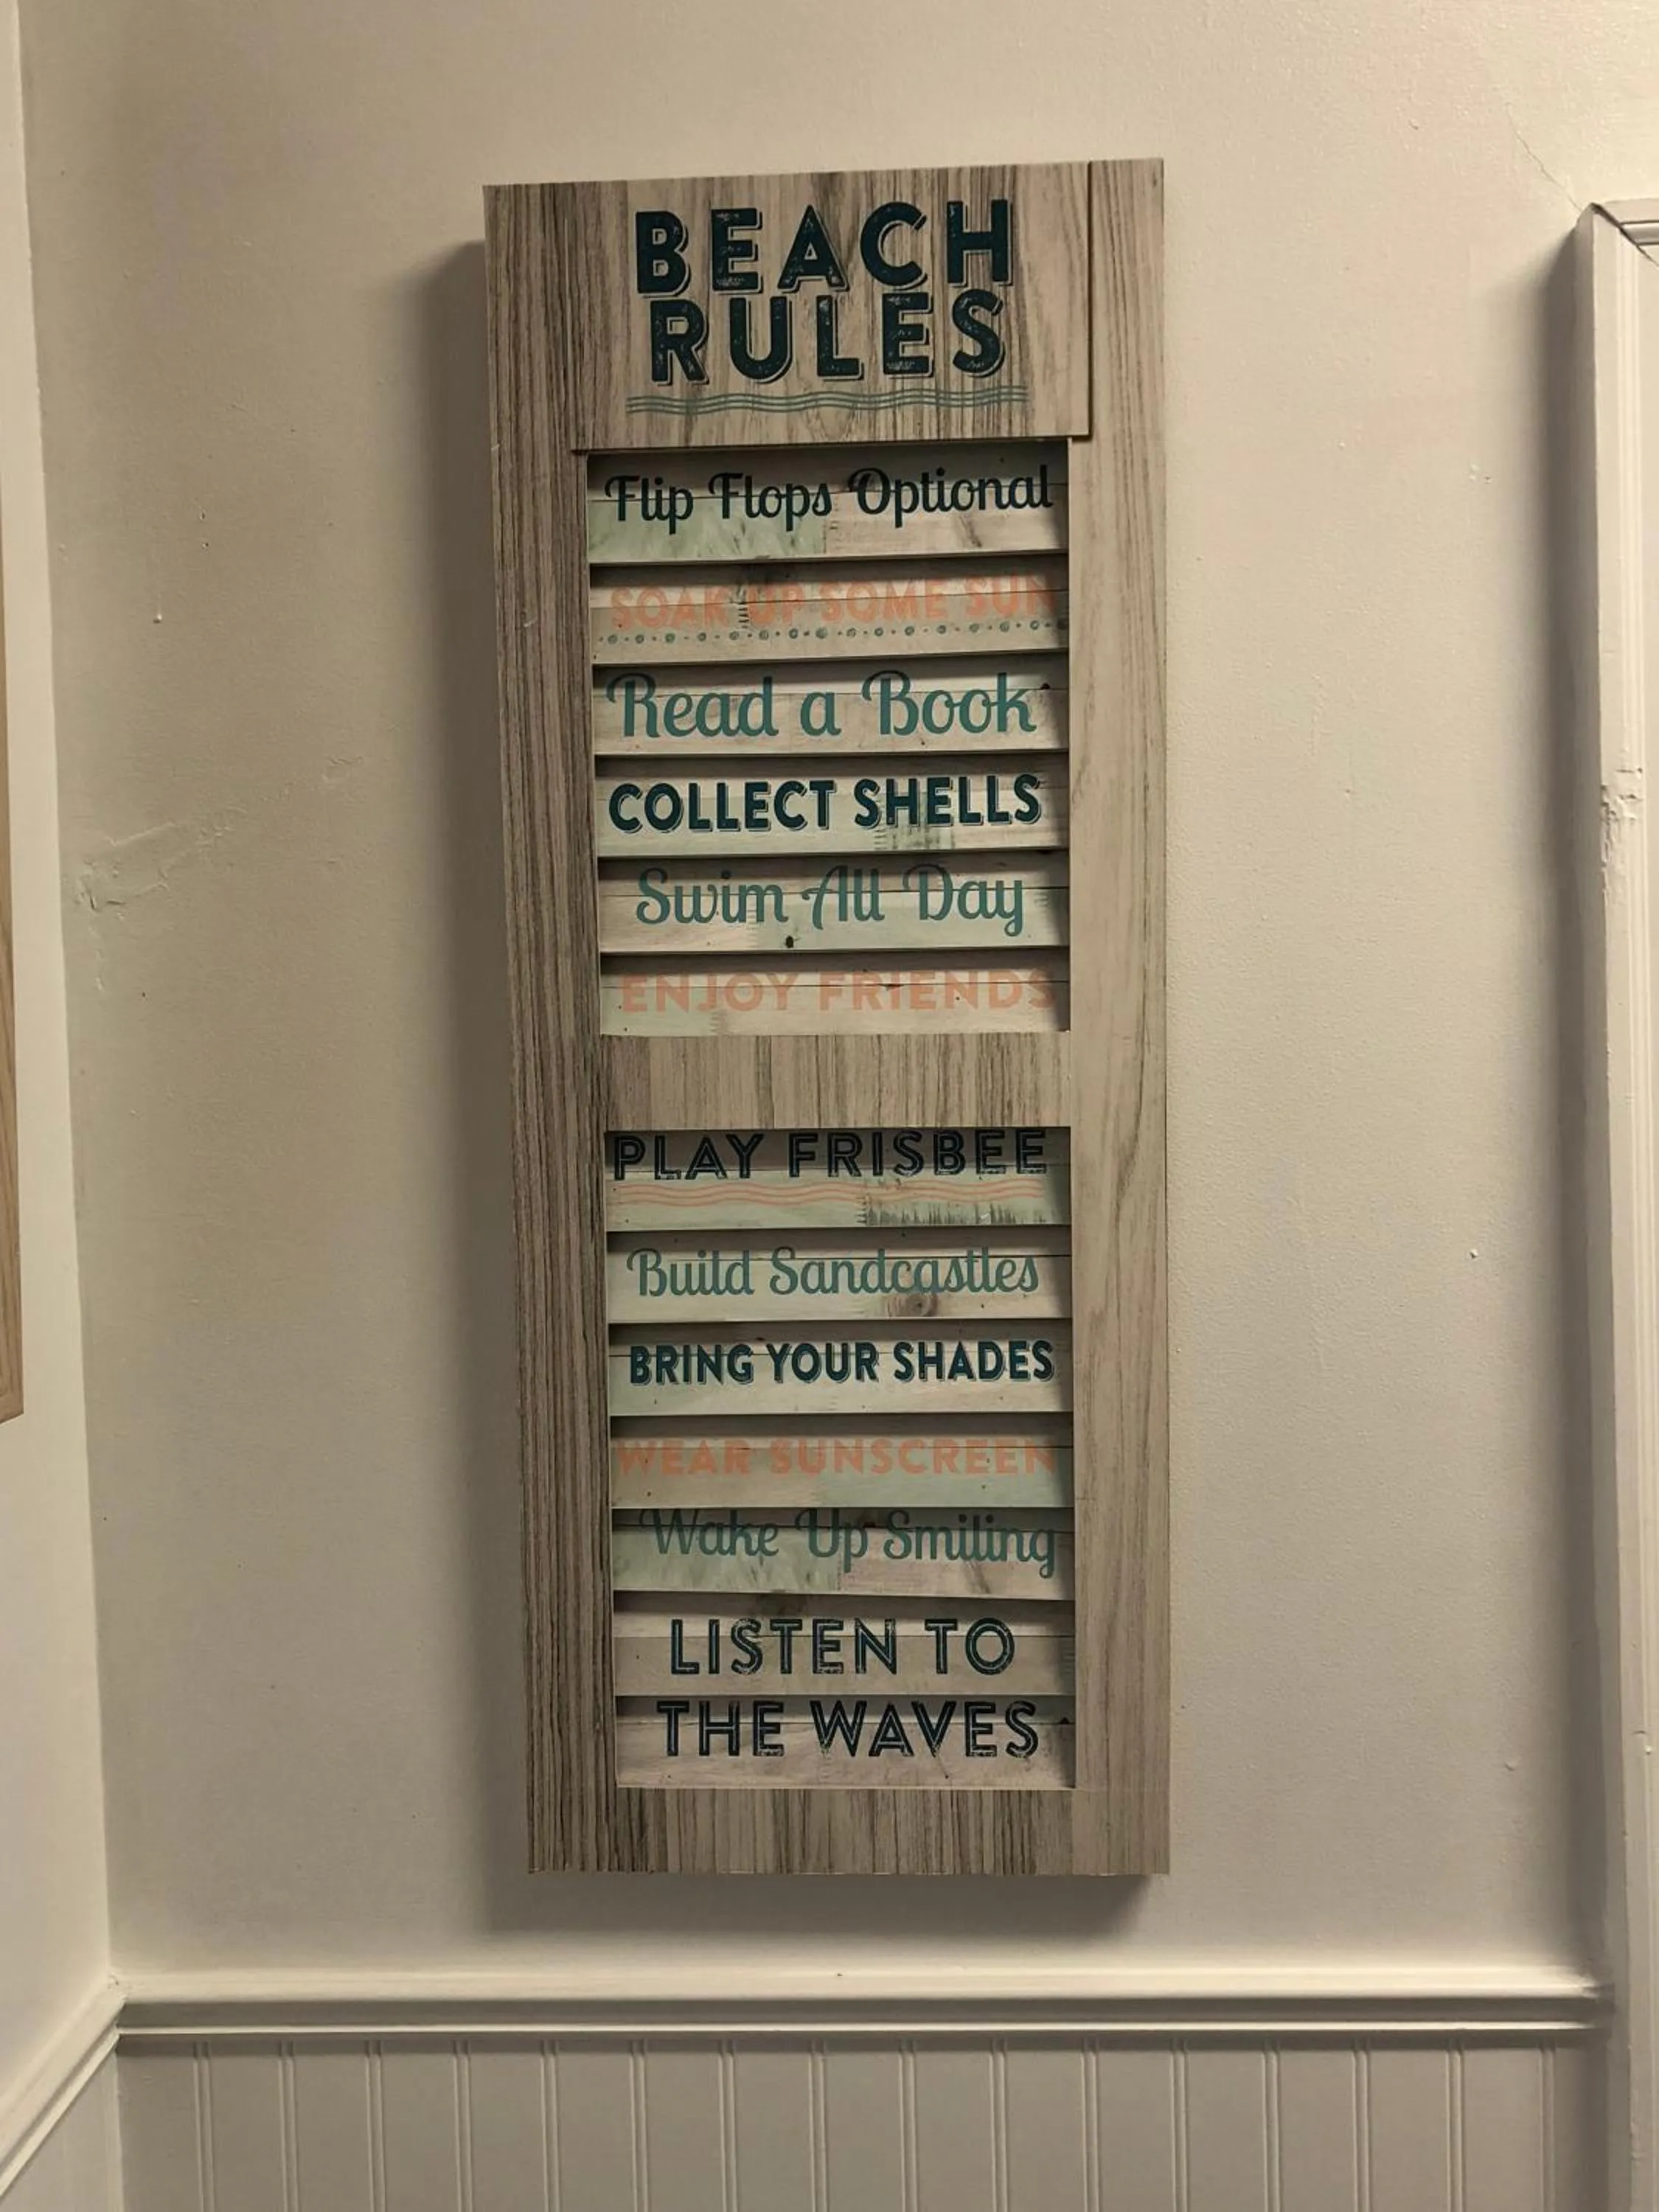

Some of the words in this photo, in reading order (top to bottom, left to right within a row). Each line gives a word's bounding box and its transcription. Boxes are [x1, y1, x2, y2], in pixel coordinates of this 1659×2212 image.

[635, 199, 1012, 294] BEACH
[650, 288, 1005, 385] RULES
[604, 474, 694, 535] Flip
[708, 472, 832, 531] Flops
[848, 465, 1054, 527] Optional
[610, 585, 730, 630] SOAK
[748, 581, 806, 625] UP
[819, 578, 947, 623] SOME
[964, 574, 1057, 619] SUN
[606, 672, 779, 737] Read
[800, 692, 841, 736] a
[862, 670, 1037, 736] Book
[608, 779, 836, 833] COLLECT
[854, 773, 1045, 828] SHELLS
[636, 867, 789, 925] Swim
[801, 865, 885, 930] All
[902, 864, 1023, 936] Day
[621, 972, 799, 1013] ENJOY
[818, 970, 1057, 1011] FRIENDS
[613, 1133, 764, 1180] PLAY
[789, 1129, 1047, 1178] FRISBEE
[627, 1248, 754, 1297] Build
[770, 1245, 1039, 1295] Sandcastles
[629, 1343, 754, 1385] BRING
[766, 1340, 880, 1384] YOUR
[894, 1339, 1055, 1382] SHADES
[615, 1439, 750, 1475] WEAR
[766, 1438, 1057, 1475] SUNSCREEN
[639, 1509, 779, 1557] Wake
[795, 1508, 869, 1573] Up
[885, 1509, 1057, 1579] Smiling
[670, 1617, 897, 1675] LISTEN
[925, 1617, 1015, 1675] TO
[657, 1700, 785, 1757] THE
[810, 1700, 1038, 1758] WAVES
